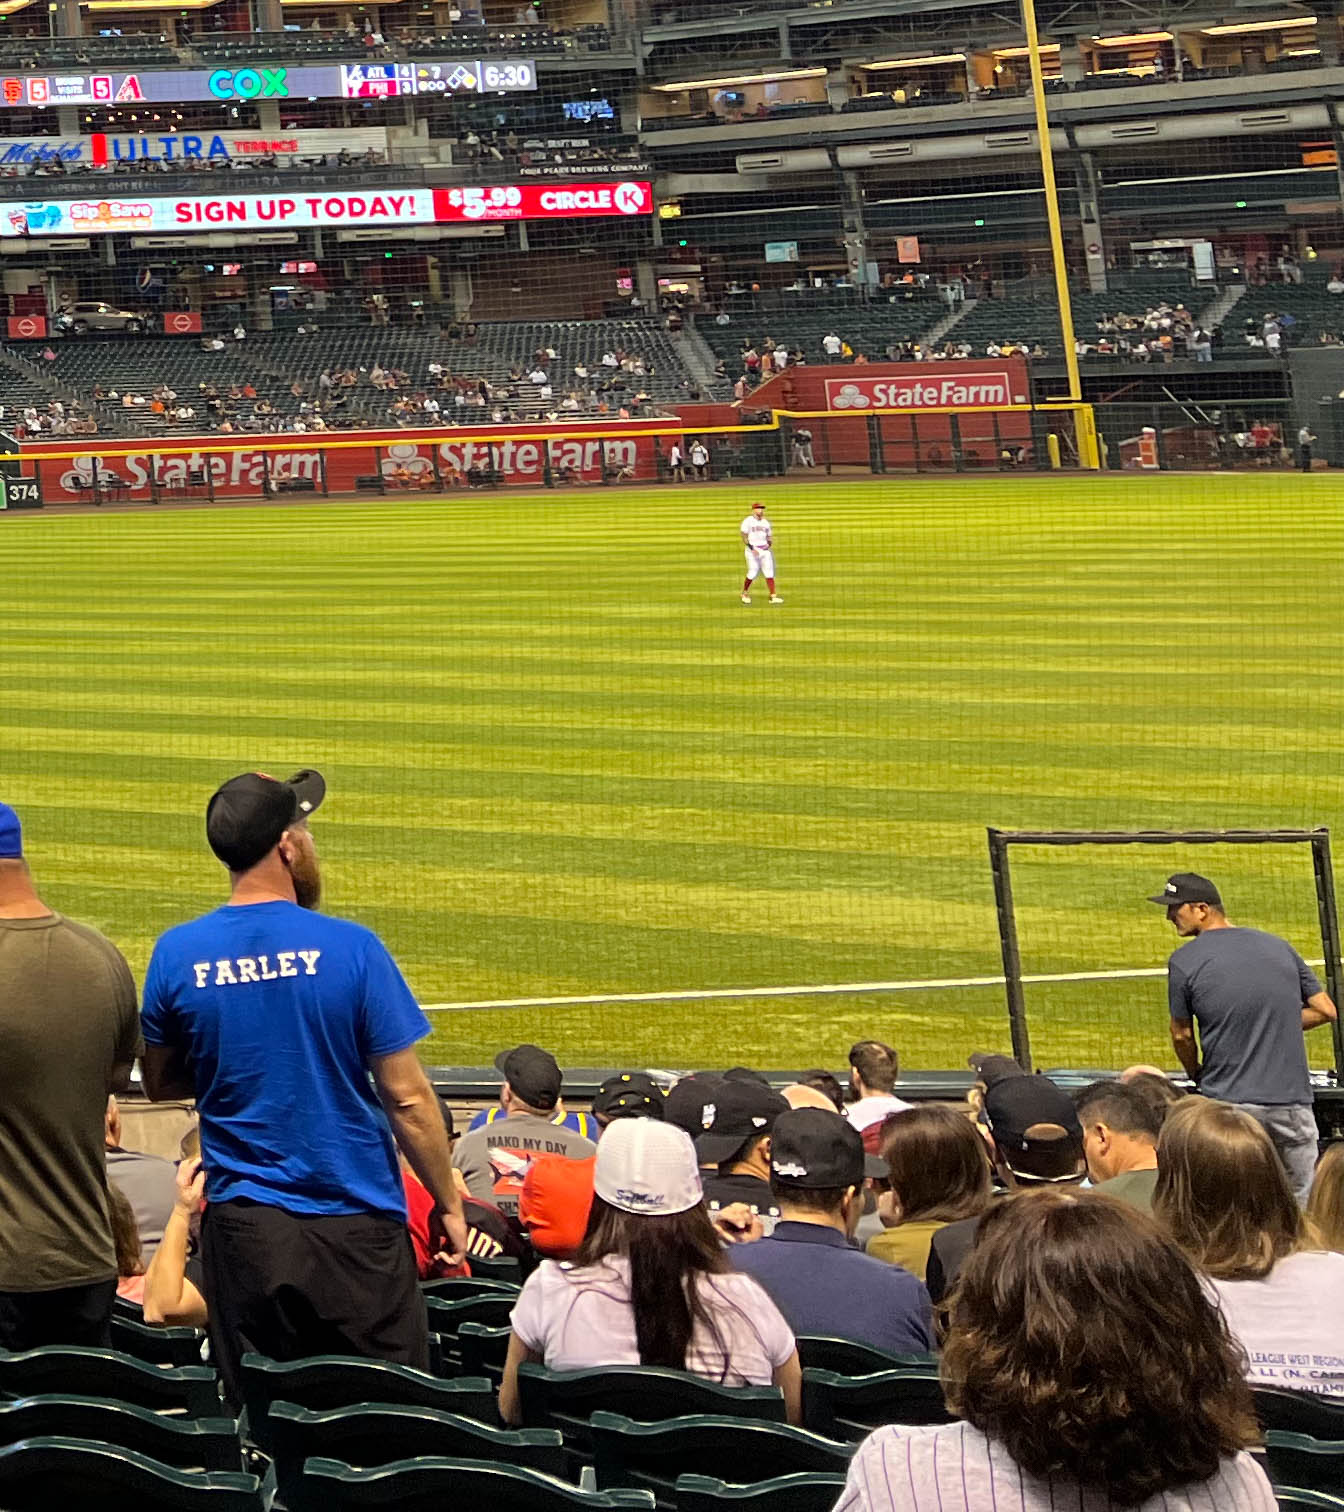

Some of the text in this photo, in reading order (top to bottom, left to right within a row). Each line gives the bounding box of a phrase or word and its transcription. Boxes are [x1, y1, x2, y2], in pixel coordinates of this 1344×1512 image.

[209, 67, 288, 99] COX
[485, 65, 530, 86] 6:30
[113, 135, 230, 162] ULTRA
[175, 195, 416, 223] SIGN UP TODAY!
[540, 189, 612, 211] CIRCLE
[9, 484, 39, 501] 374
[193, 950, 321, 989] FARLEY
[487, 1136, 567, 1155] MAKO MY DAY
